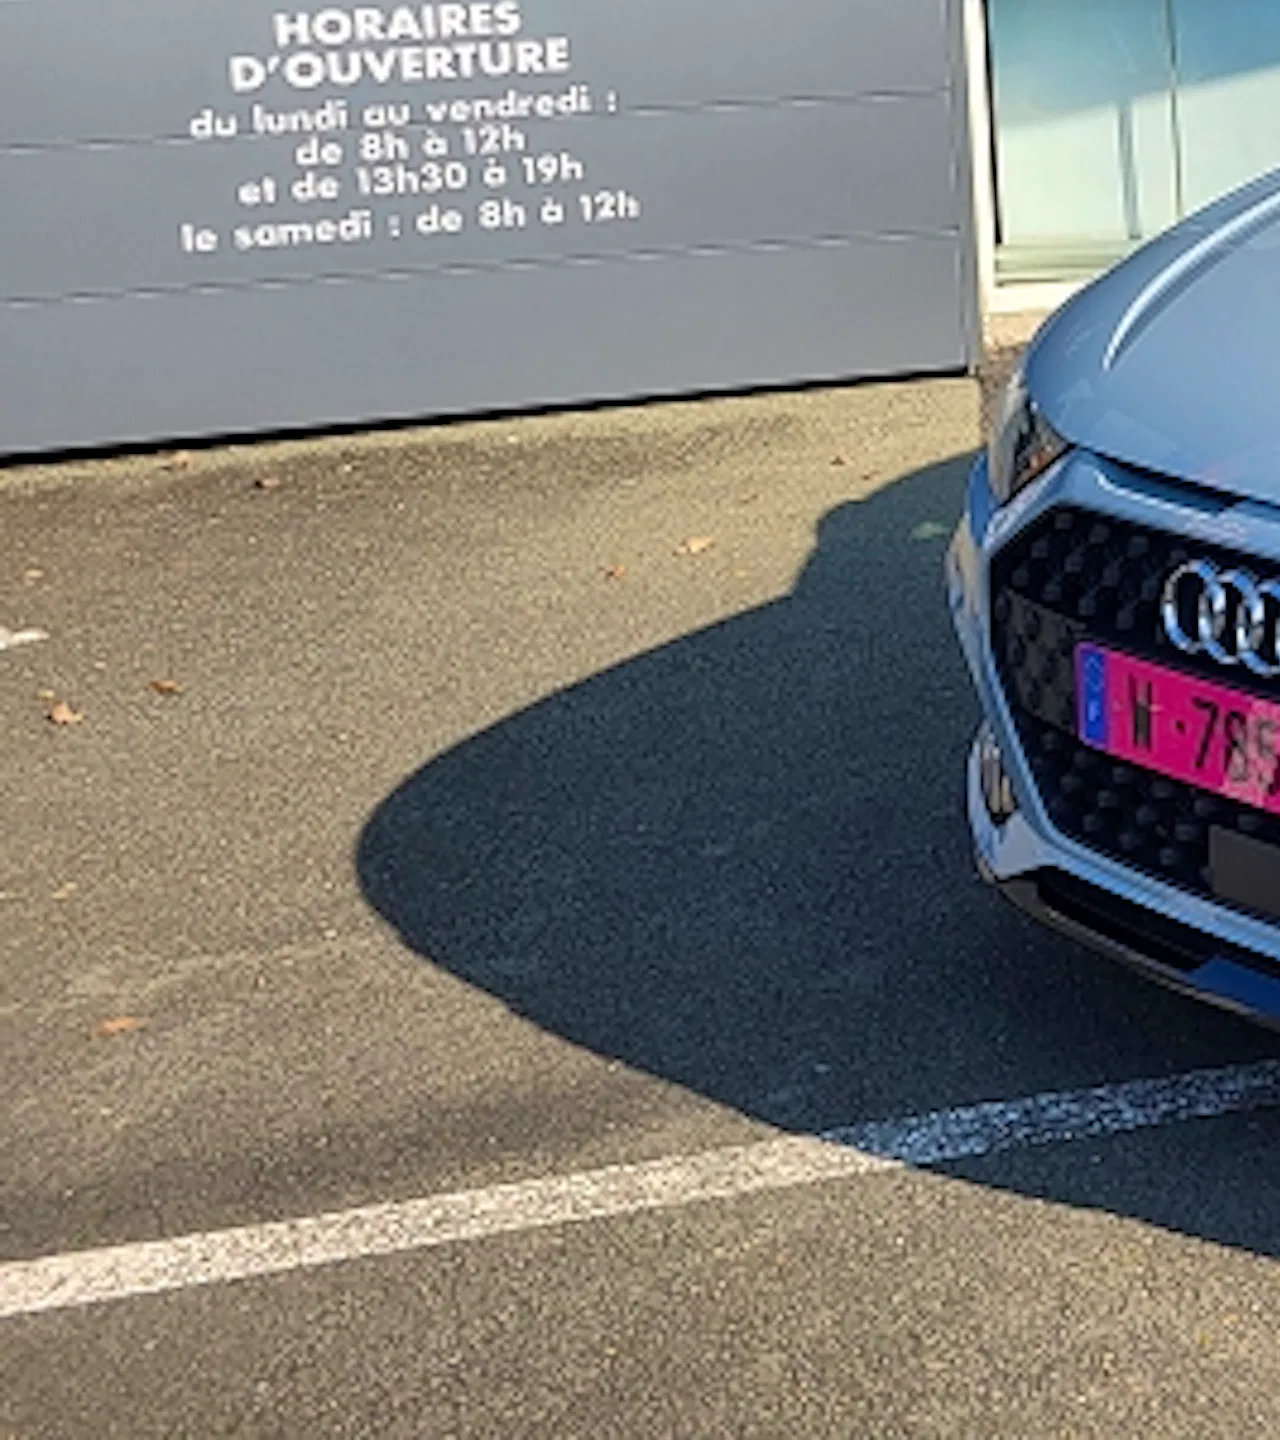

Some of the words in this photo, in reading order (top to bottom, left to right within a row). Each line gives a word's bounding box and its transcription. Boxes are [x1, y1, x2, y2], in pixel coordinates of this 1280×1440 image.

[273, 0, 521, 47] HORAIRES
[229, 37, 570, 92] D'OUVERTURE
[189, 109, 238, 139] du
[252, 101, 348, 134] lundi
[363, 106, 410, 127] au
[425, 86, 592, 122] vendredi
[296, 138, 343, 166] de
[359, 133, 409, 162] 8h
[423, 128, 448, 157] à
[463, 125, 526, 153] 12h
[238, 177, 276, 205] et
[292, 172, 340, 201] de
[357, 162, 467, 195] 13h30
[484, 157, 508, 186] à
[521, 153, 585, 183] 19h
[181, 223, 218, 253] le
[234, 210, 372, 250] samedi
[416, 205, 464, 235] de
[478, 200, 527, 229] 8h
[541, 195, 565, 224] à
[579, 191, 641, 222] 12h
